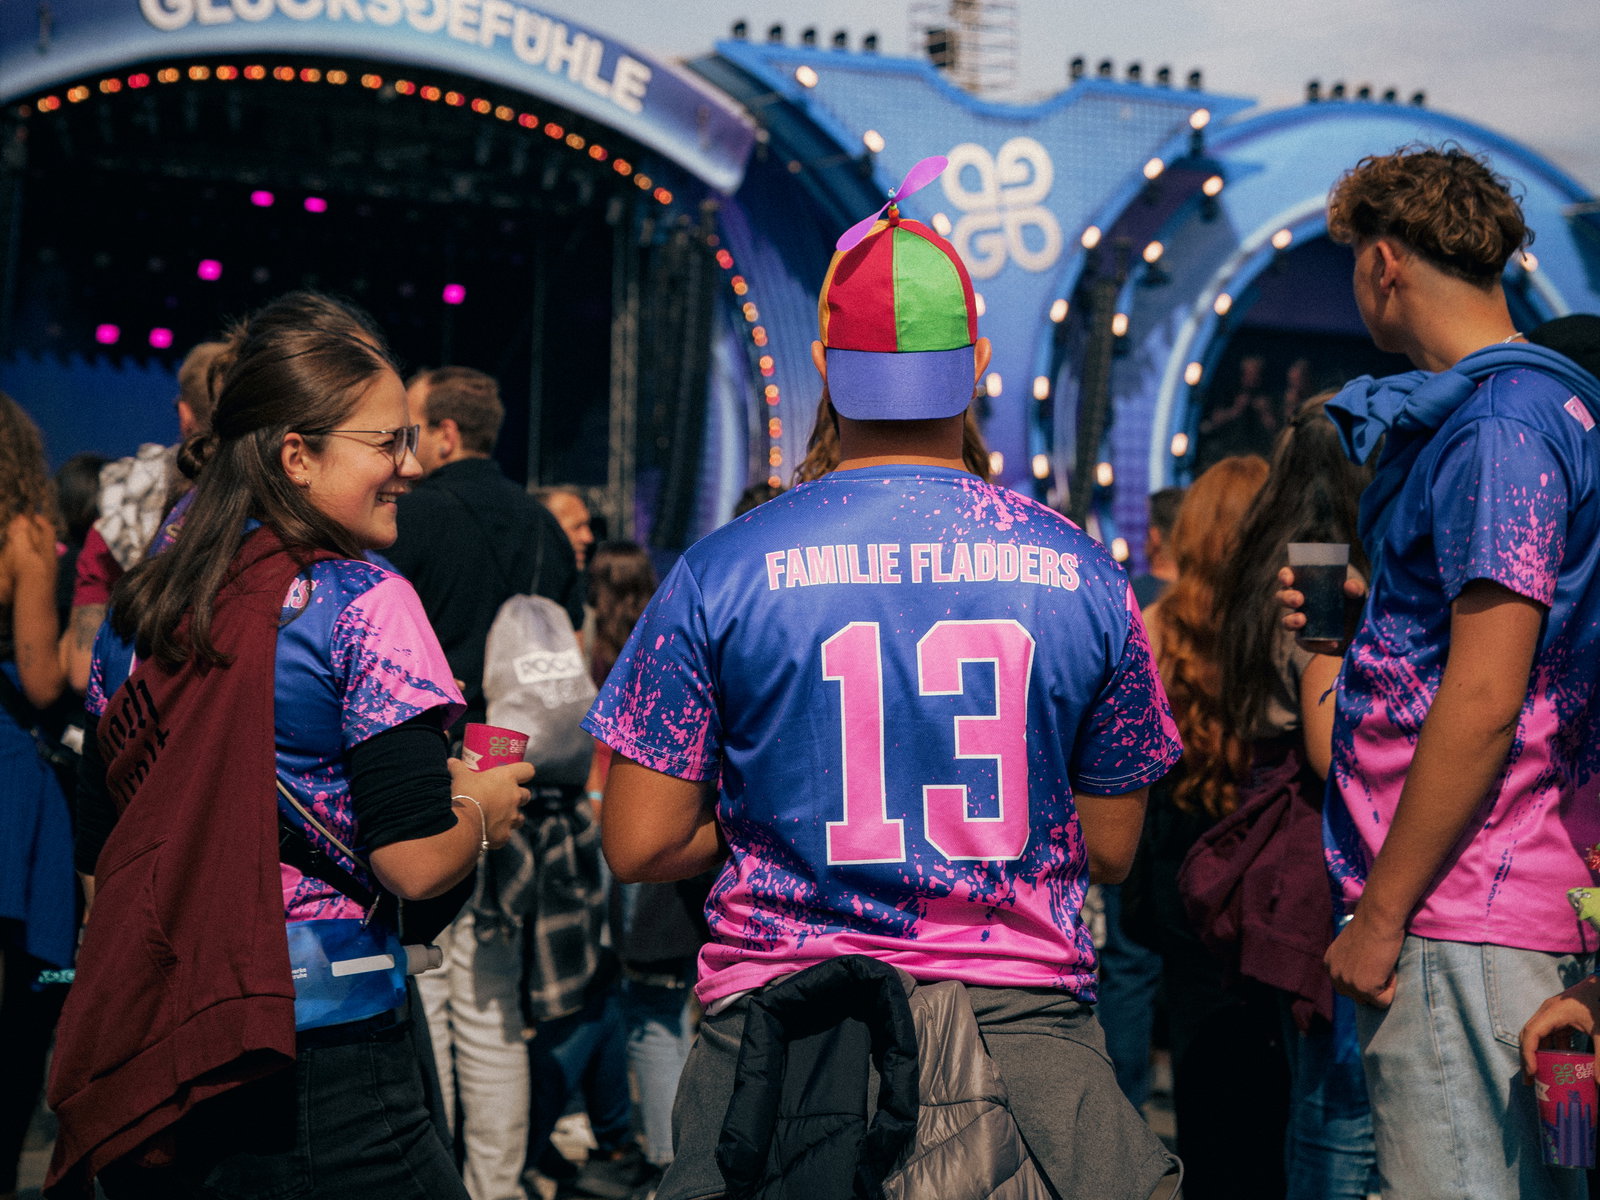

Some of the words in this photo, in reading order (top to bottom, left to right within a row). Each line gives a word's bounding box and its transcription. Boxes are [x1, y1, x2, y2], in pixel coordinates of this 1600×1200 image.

[765, 544, 901, 590] FAMILIE
[910, 543, 1080, 591] FLADDERS
[821, 619, 1036, 865] 13
